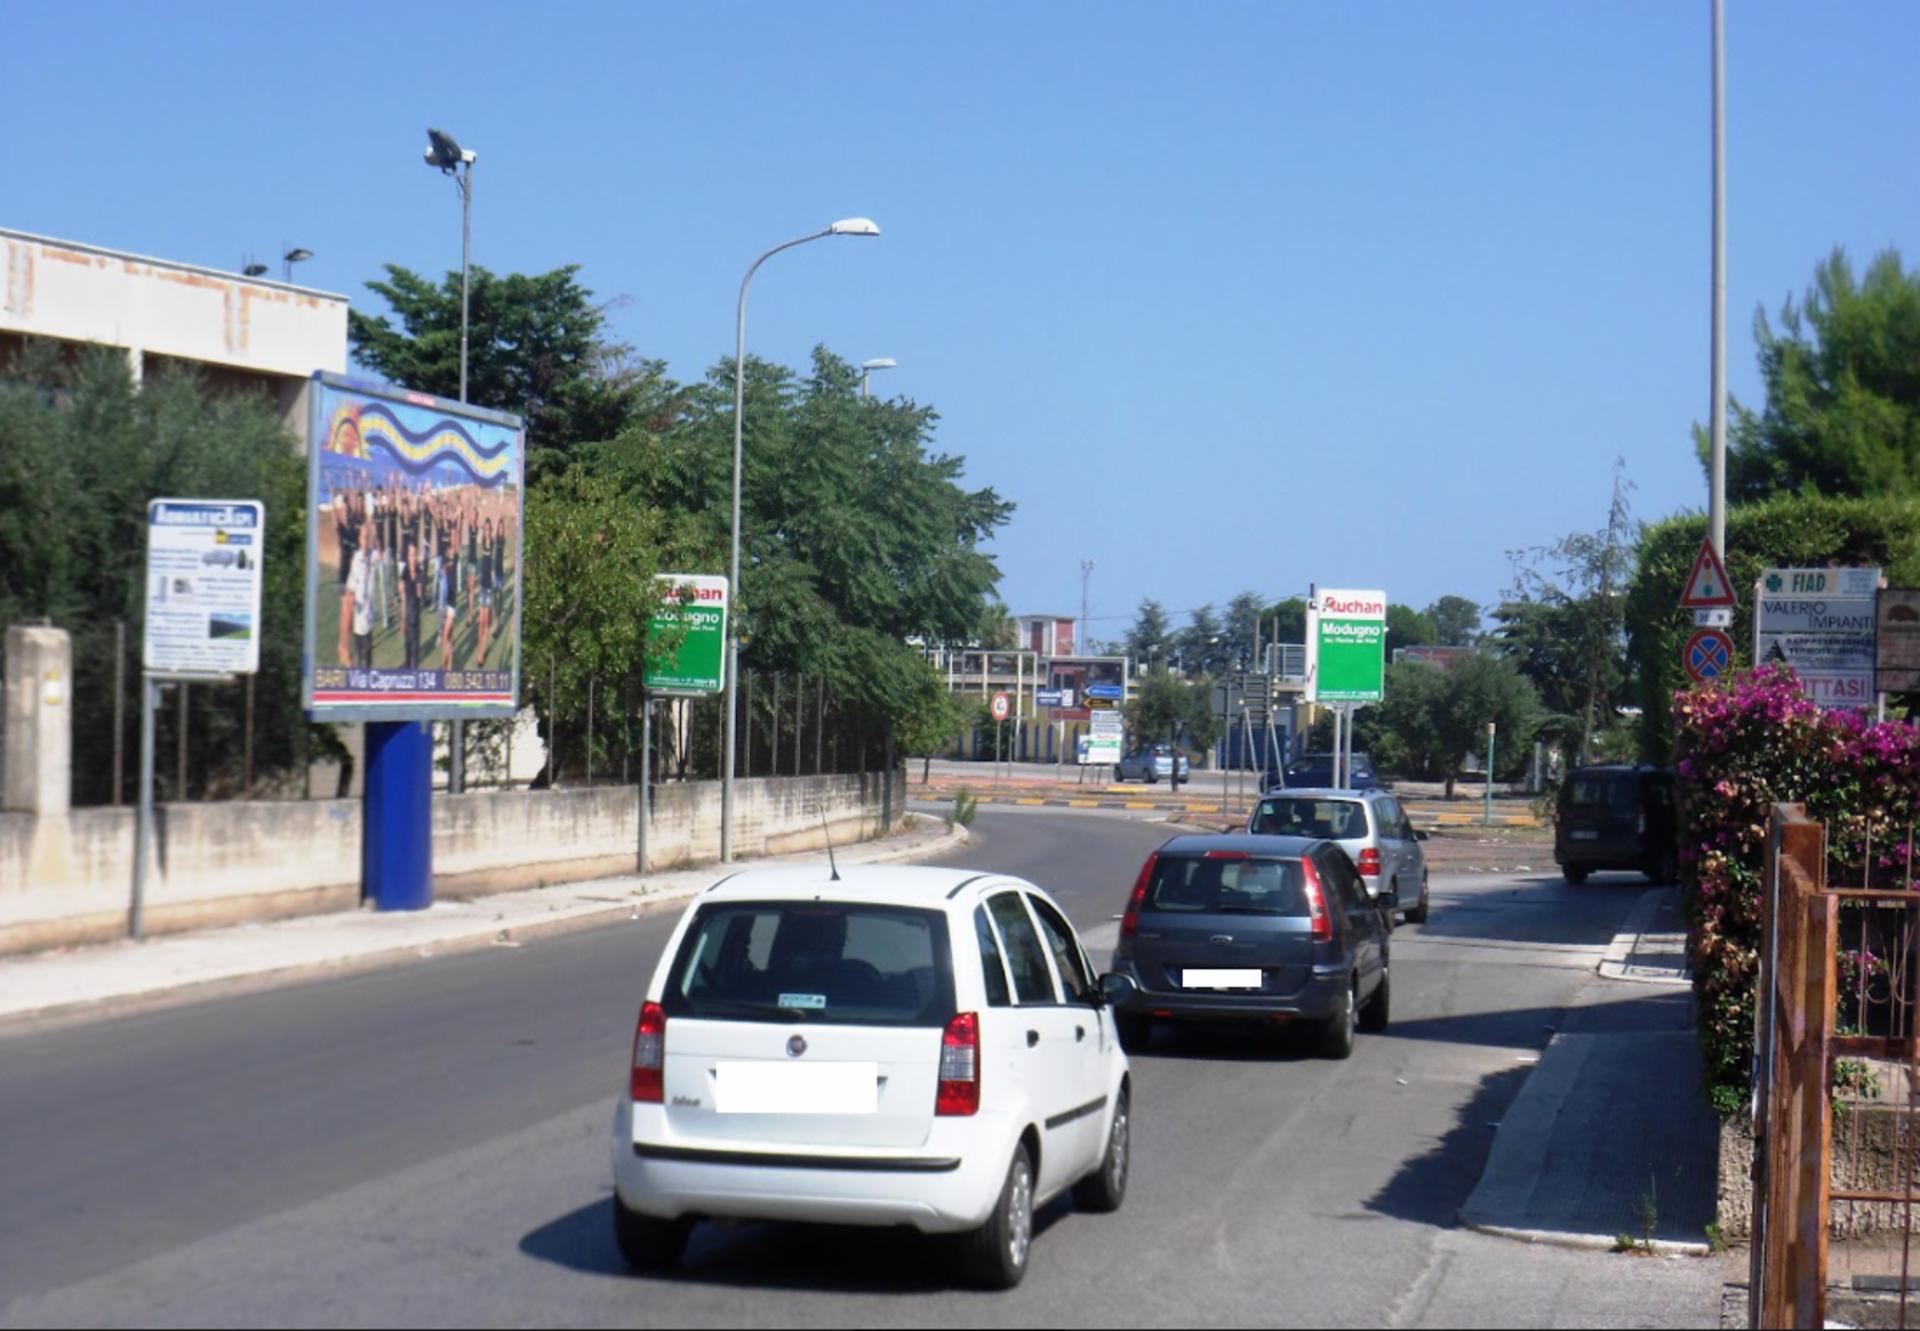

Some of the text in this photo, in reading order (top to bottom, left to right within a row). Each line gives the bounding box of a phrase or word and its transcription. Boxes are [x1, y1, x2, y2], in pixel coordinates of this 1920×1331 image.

[1792, 573, 1826, 592] FIAD
[665, 586, 722, 600] uhan
[1322, 597, 1382, 613] Auchan
[1764, 601, 1826, 615] VALERIO
[656, 611, 720, 626] ougno
[1808, 615, 1875, 629] IMPIANTI
[1322, 623, 1380, 638] Modugno
[314, 669, 345, 688] BARI
[349, 670, 367, 688] Via
[368, 671, 415, 691] Capruzzi
[418, 672, 436, 688] 134
[1803, 678, 1866, 697] ITTASI
